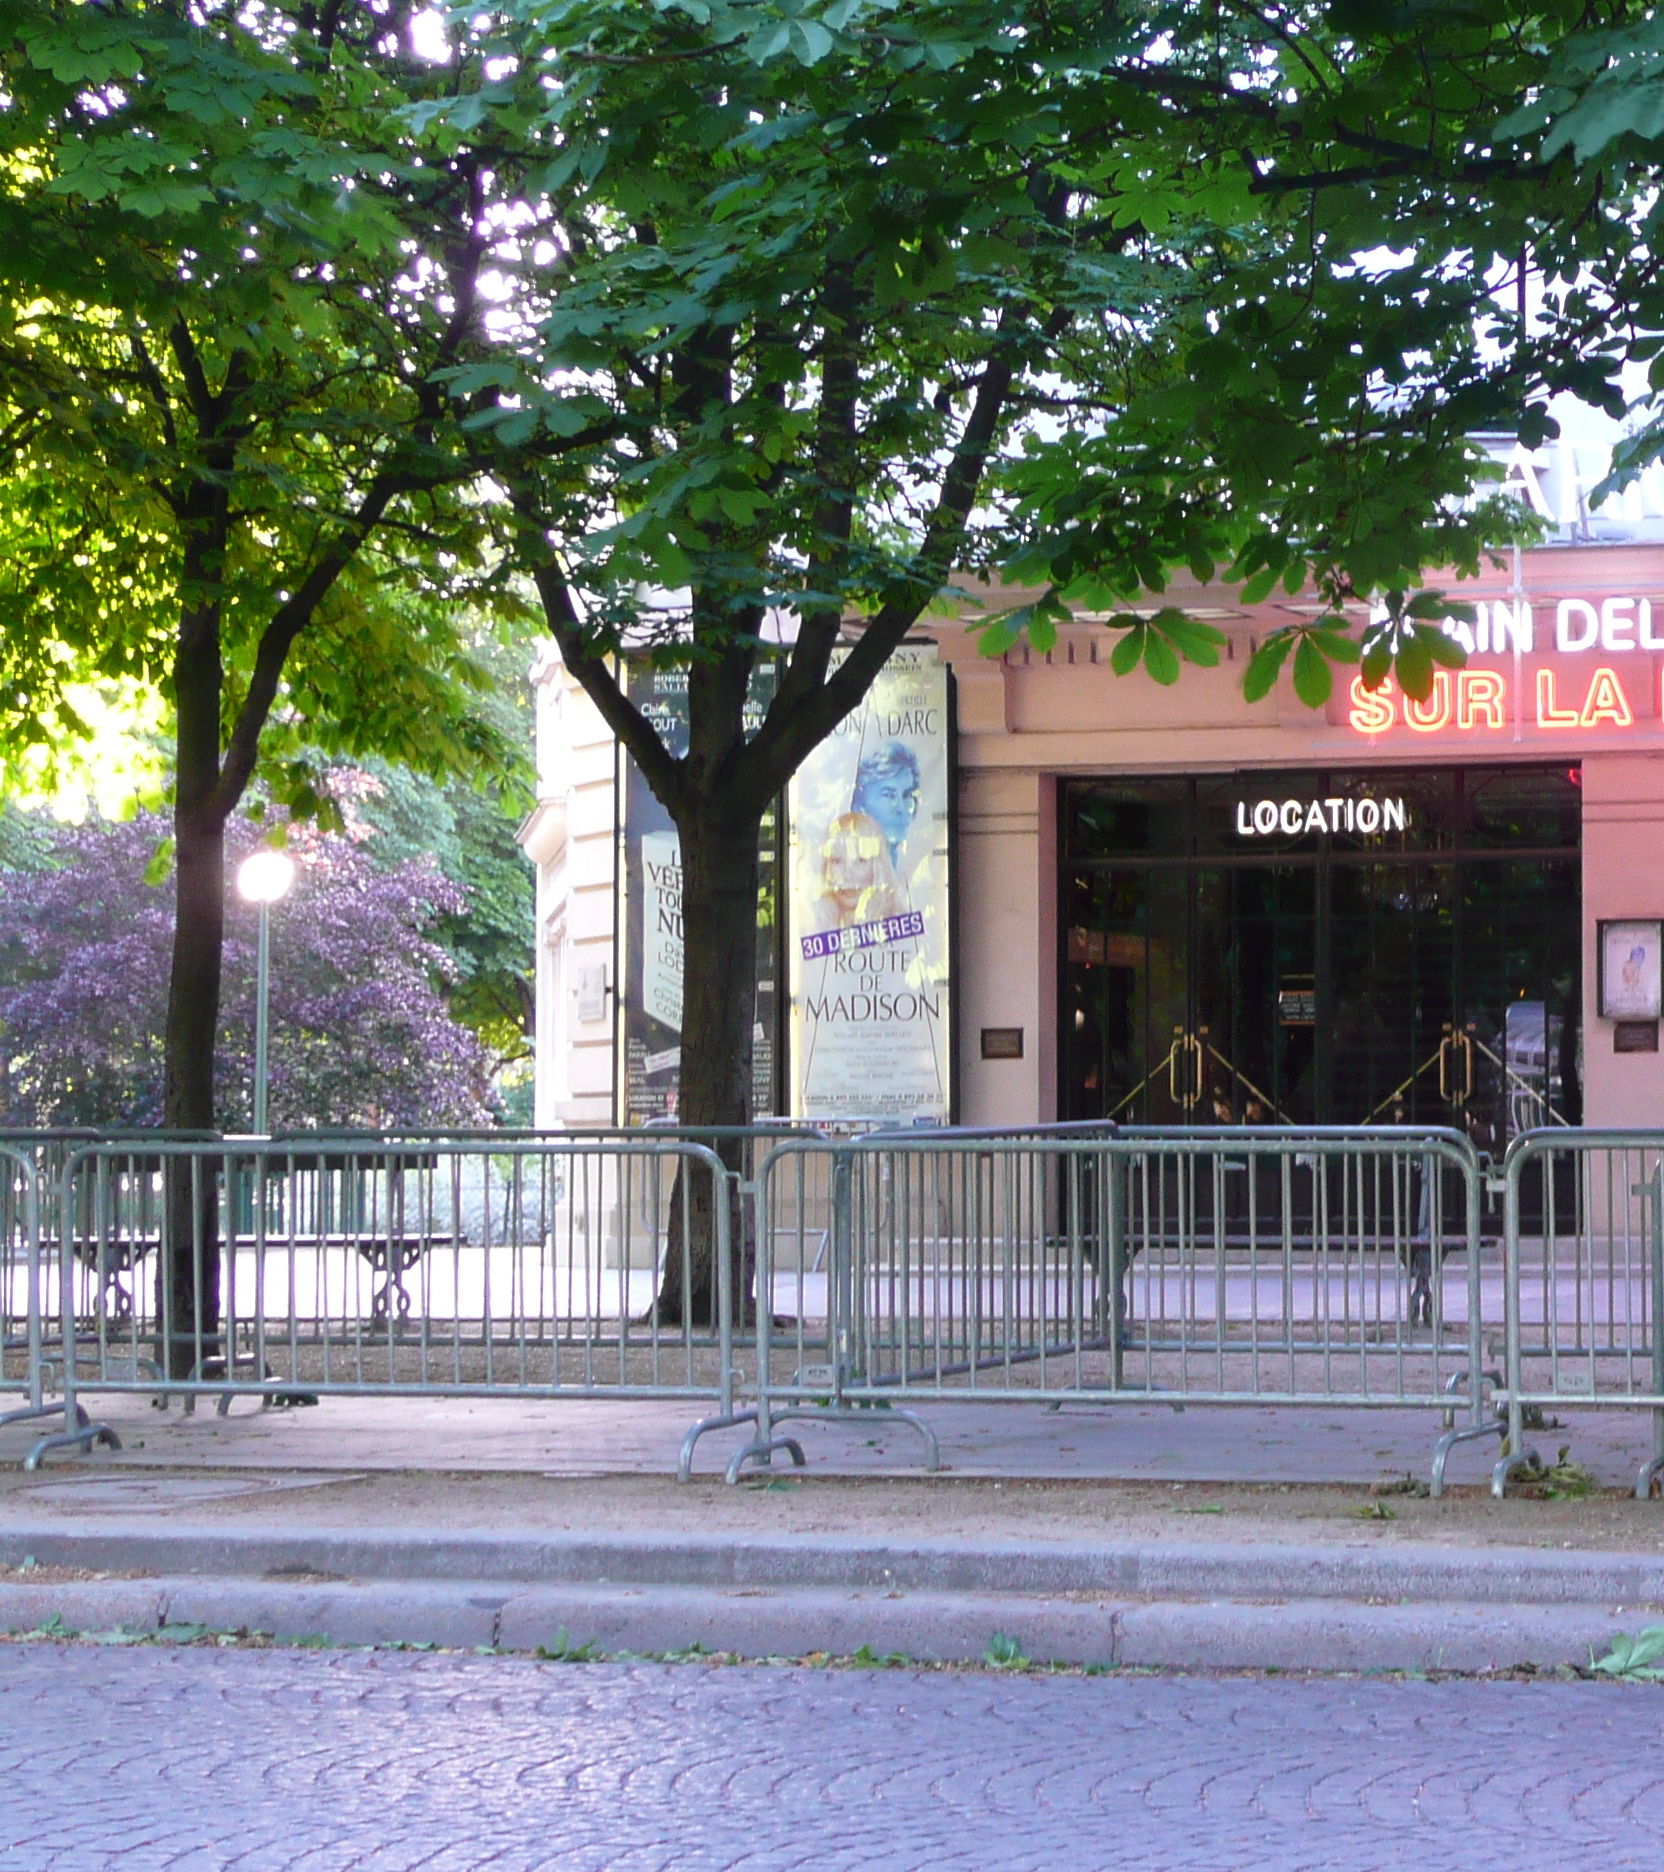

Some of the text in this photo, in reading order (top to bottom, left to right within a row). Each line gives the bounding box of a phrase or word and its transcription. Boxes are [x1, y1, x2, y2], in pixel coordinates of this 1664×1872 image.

[1348, 669, 1504, 734] SUR
[1536, 667, 1633, 729] LA
[888, 708, 938, 736] DARC
[1237, 798, 1404, 834] LOCATION
[803, 936, 824, 958] 30
[834, 950, 912, 974] ROUTE
[860, 974, 883, 993] DE
[805, 992, 940, 1023] MADISON
